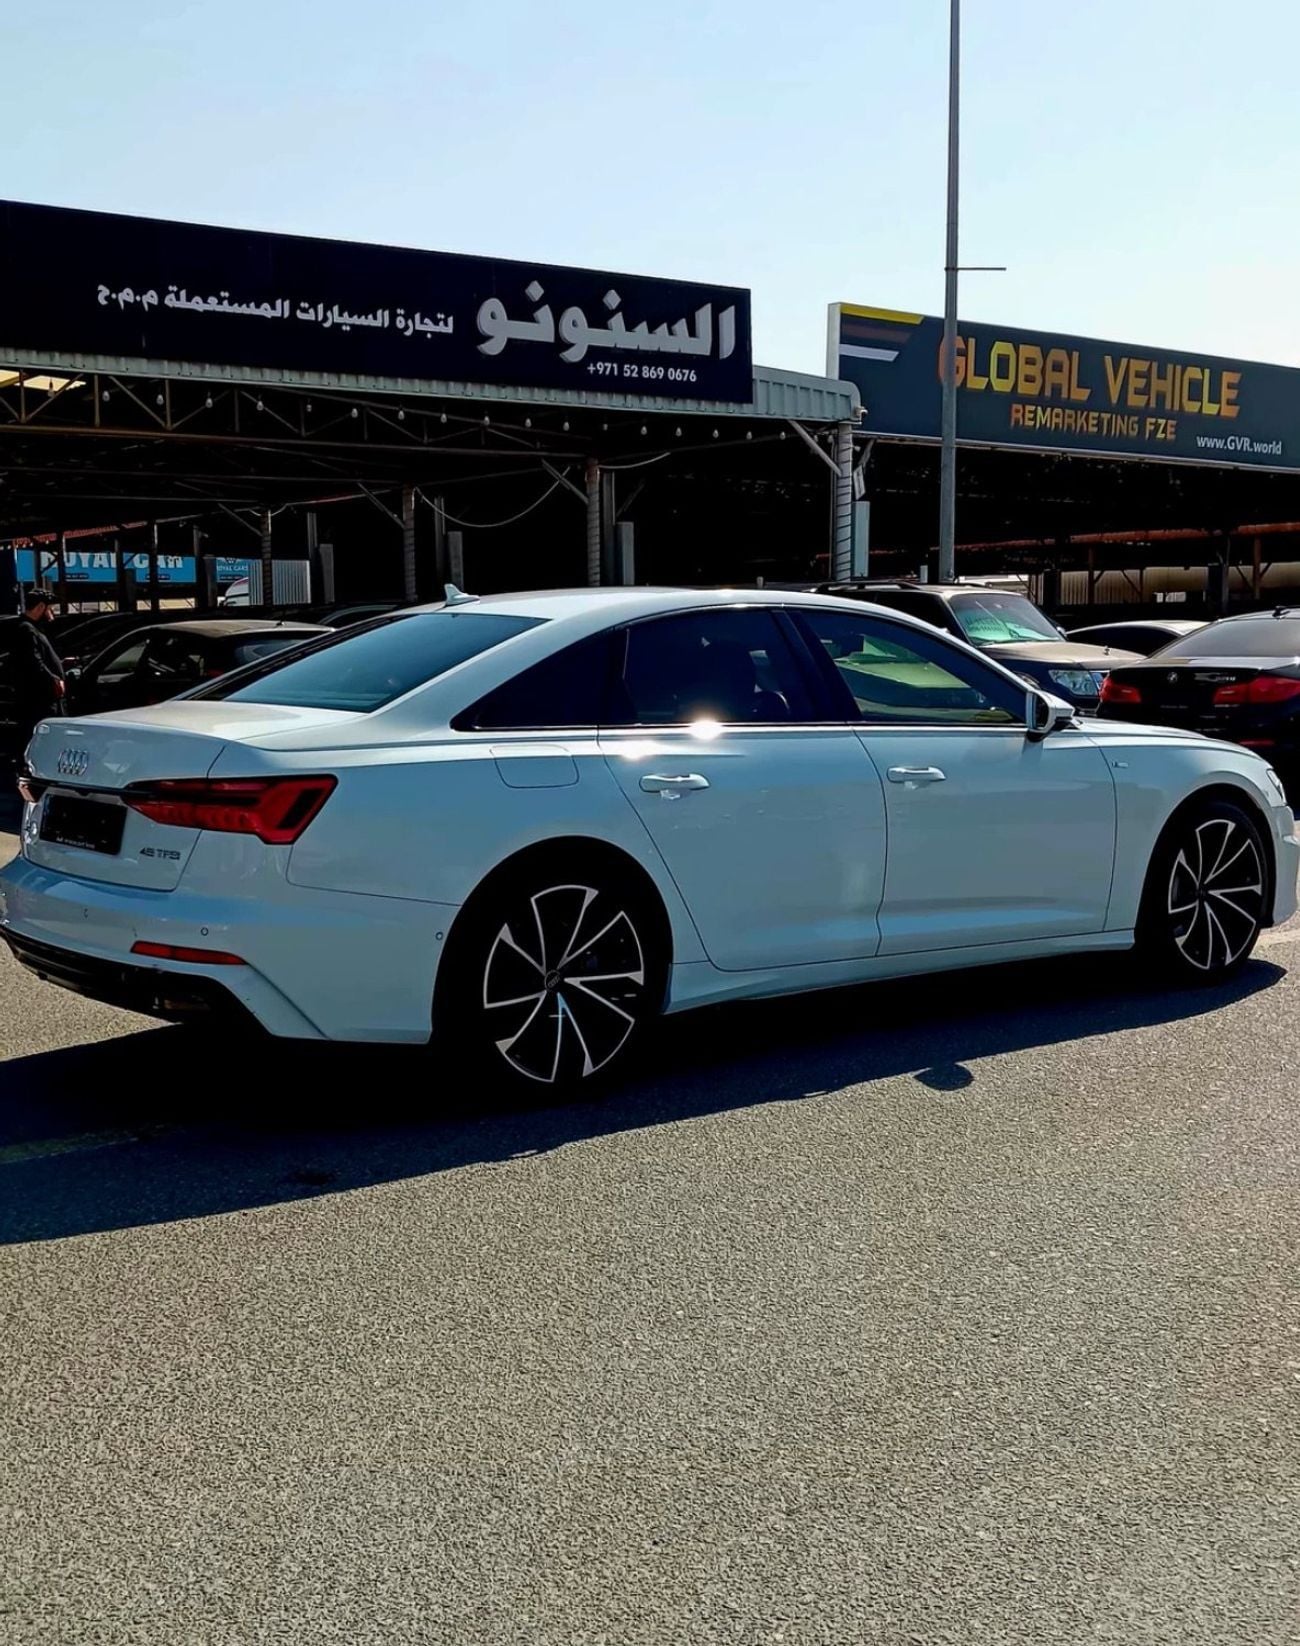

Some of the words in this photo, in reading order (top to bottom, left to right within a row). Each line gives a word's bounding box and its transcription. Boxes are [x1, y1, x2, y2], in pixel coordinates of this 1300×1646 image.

[164, 285, 290, 319] المستعملة
[296, 302, 389, 332] السيارات
[396, 308, 453, 339] لتجارة
[477, 280, 736, 363] السنونو
[587, 361, 618, 376] +971
[623, 364, 639, 378] 52
[642, 365, 665, 379] 869
[667, 367, 697, 382] 0676
[938, 335, 1091, 401] GLOBAL
[1104, 355, 1242, 418] VEHICLE
[1011, 403, 1140, 437] REMARKETING
[1145, 417, 1177, 440] FZE
[1197, 435, 1282, 455] www.GVR.world
